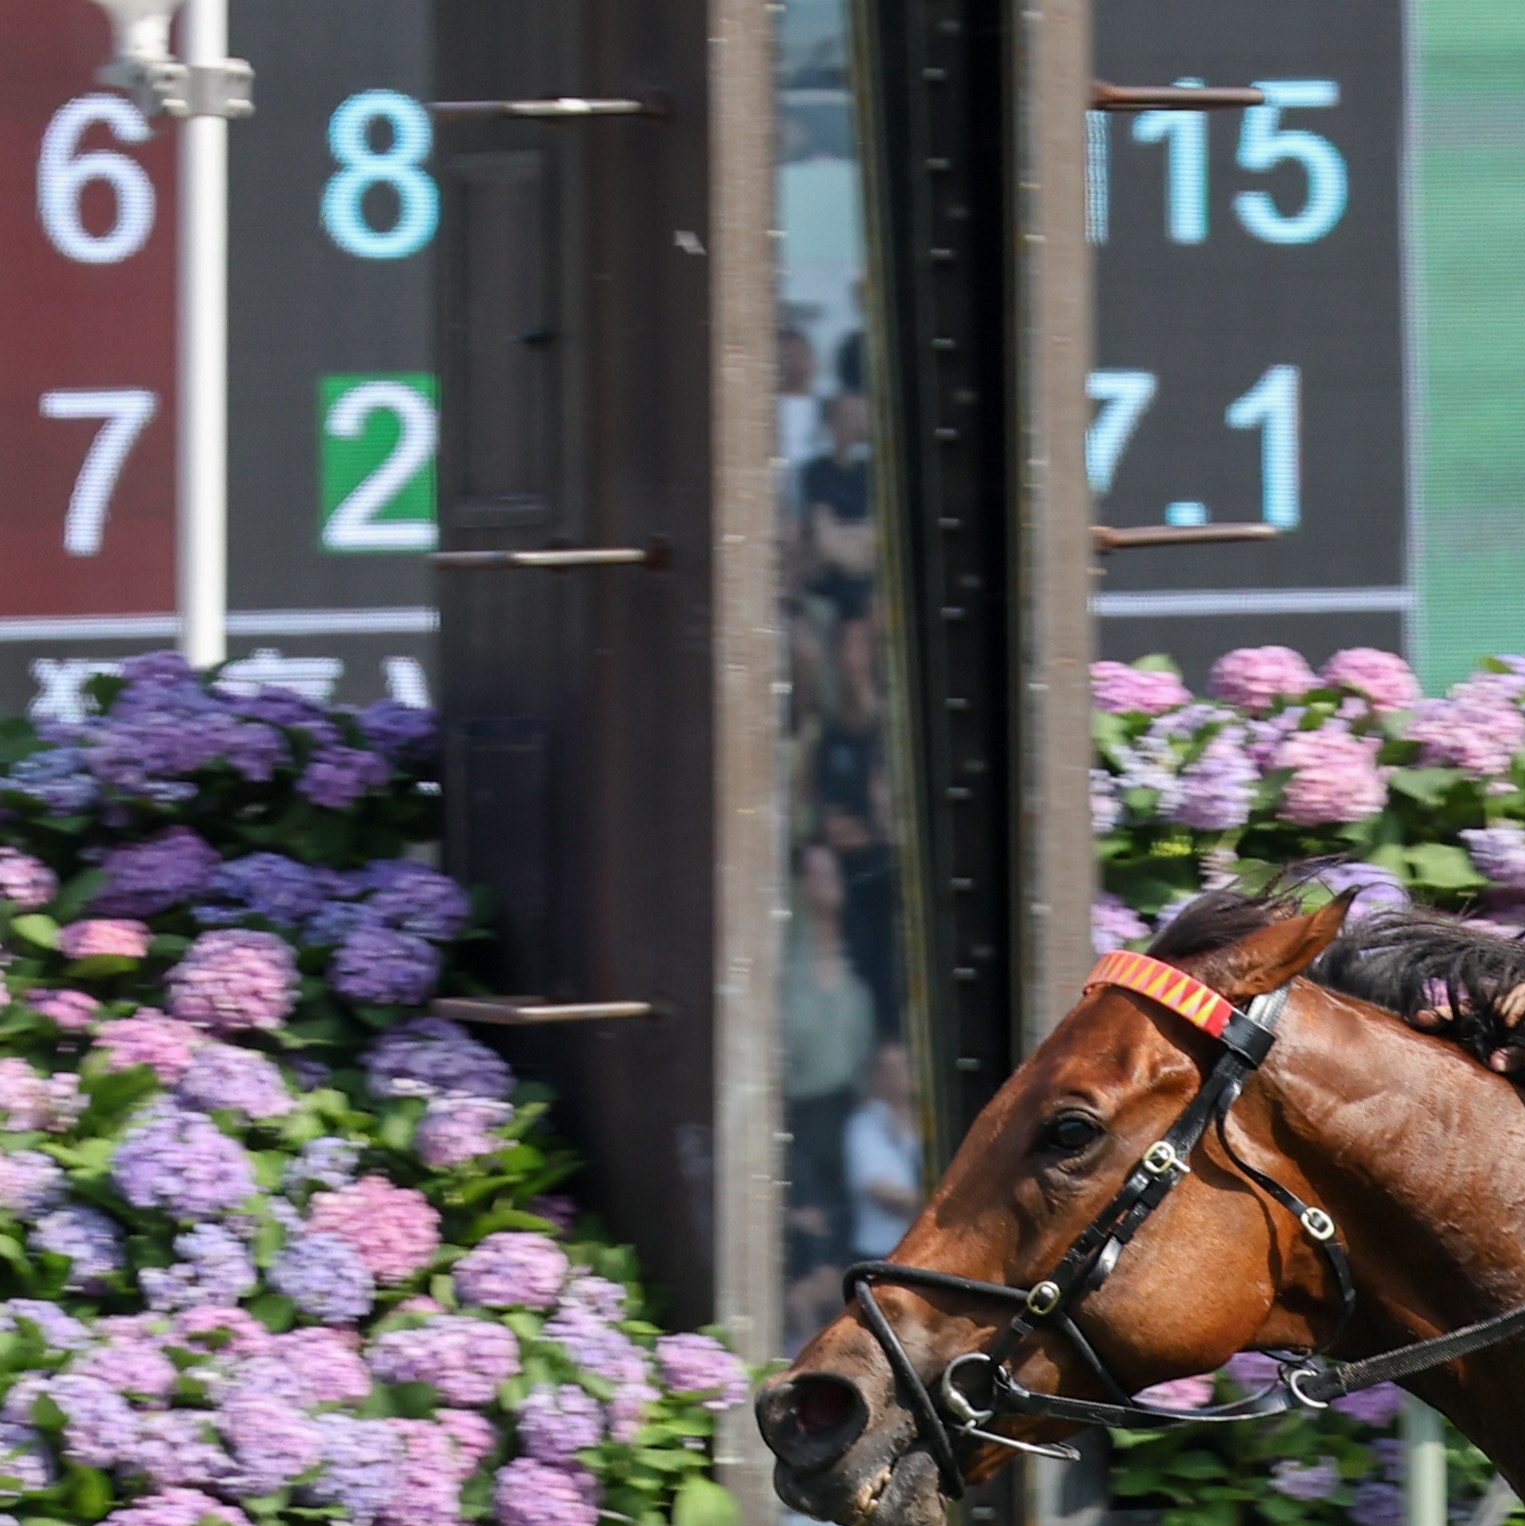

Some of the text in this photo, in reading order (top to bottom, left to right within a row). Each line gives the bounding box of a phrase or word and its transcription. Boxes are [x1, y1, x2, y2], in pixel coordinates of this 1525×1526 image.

[37, 91, 154, 263] 6
[321, 89, 441, 259] 8
[40, 390, 157, 556] 7
[322, 380, 440, 550] 2
